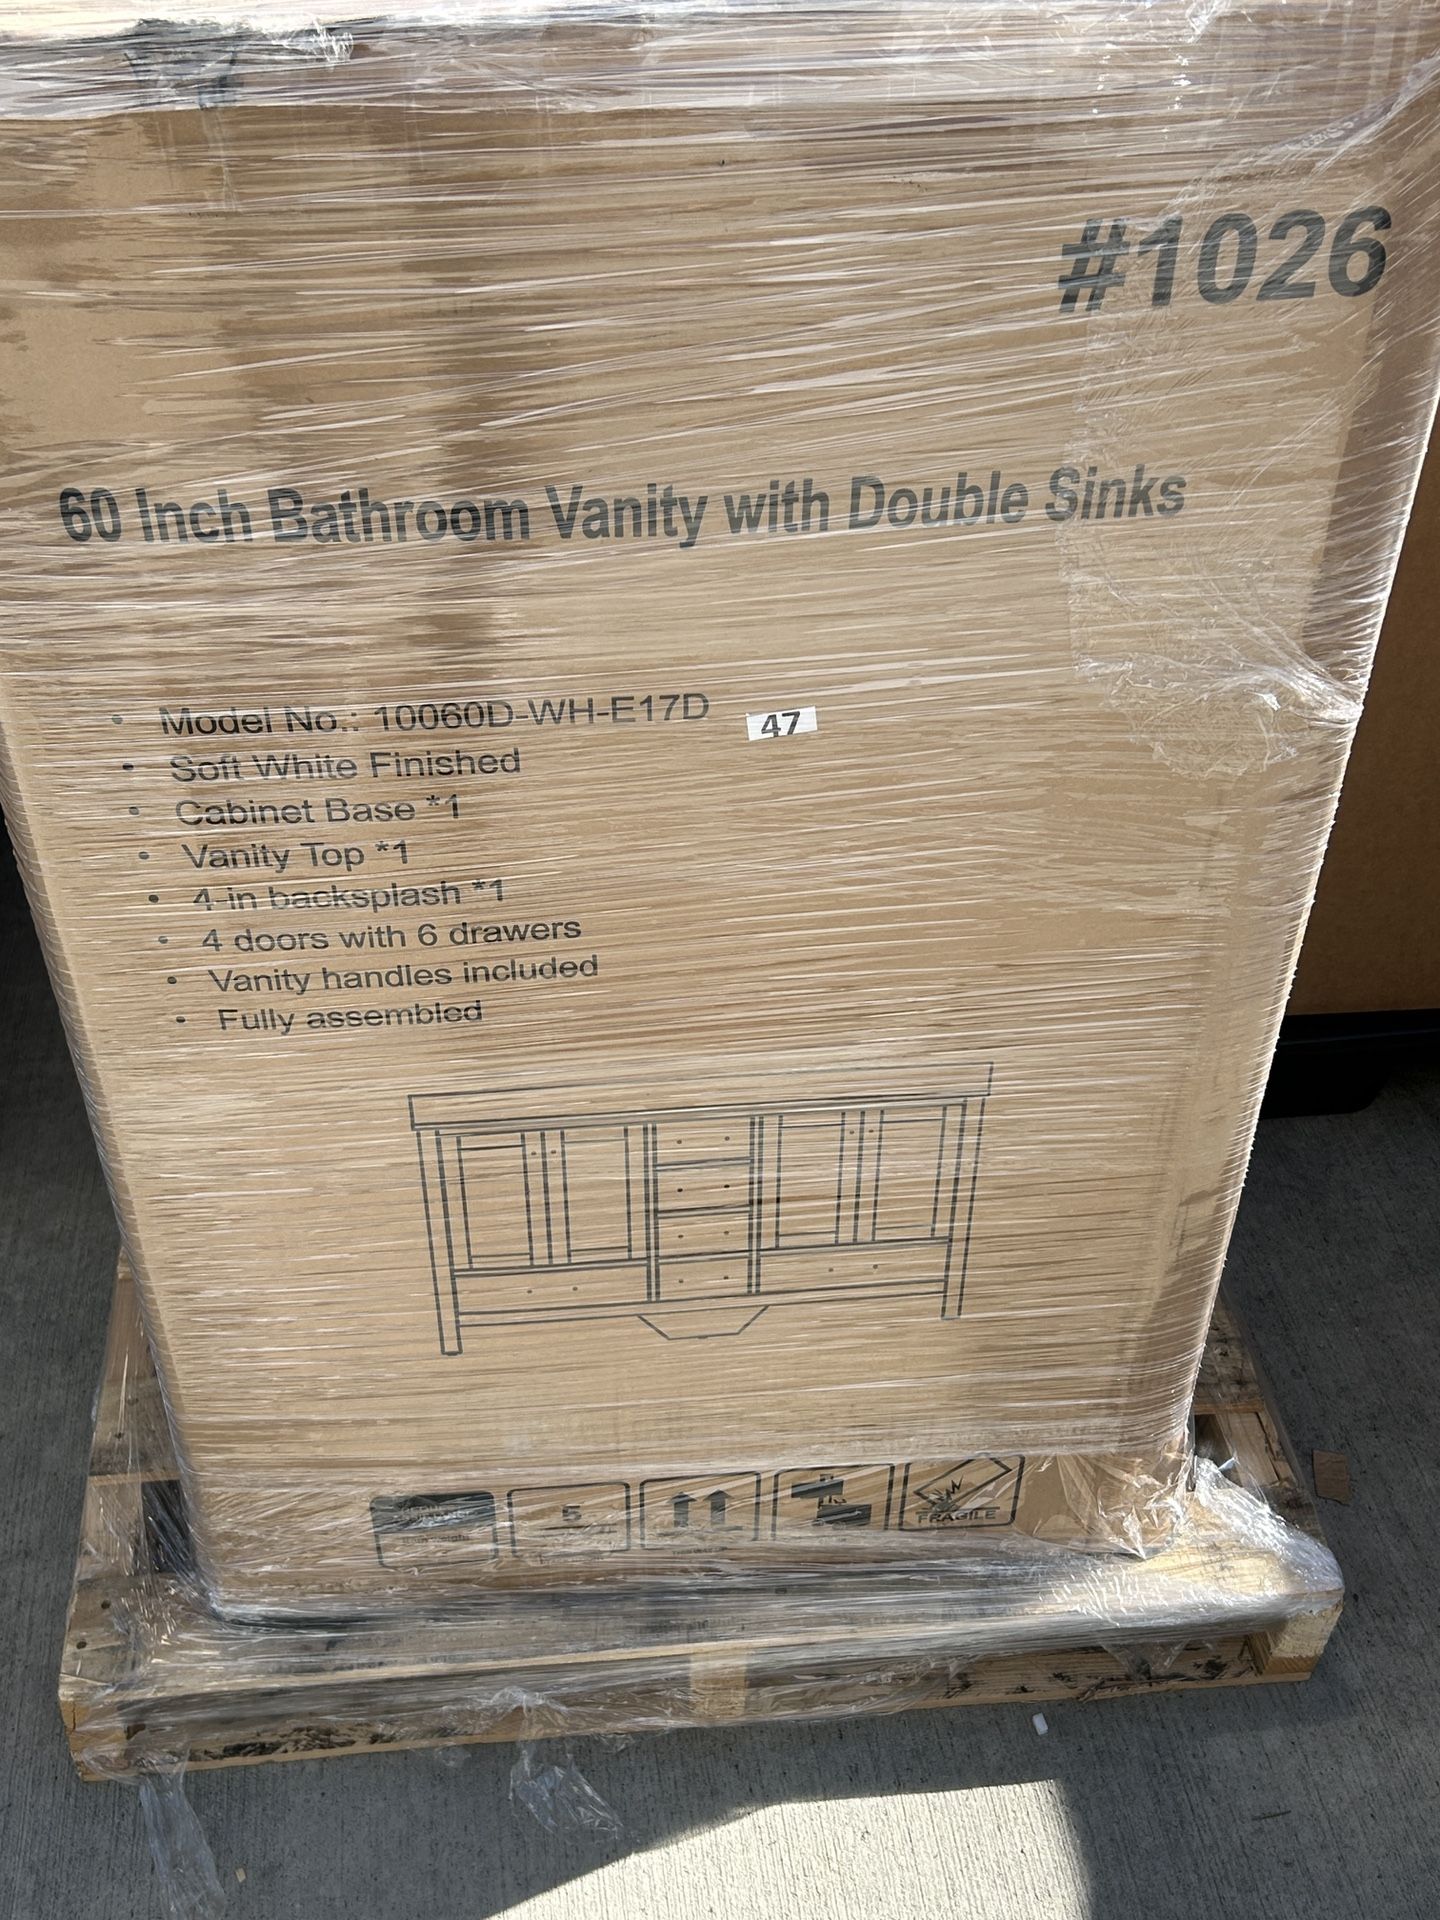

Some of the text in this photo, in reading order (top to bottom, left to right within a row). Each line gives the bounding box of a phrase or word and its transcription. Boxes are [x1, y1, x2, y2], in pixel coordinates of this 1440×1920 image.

[1057, 205, 1392, 313] #1026
[59, 462, 1189, 549] 60 Inch Bathroom Vanity with Double Sinks
[158, 692, 710, 736] Model No.: 10060D-WH-E17D
[760, 710, 801, 737] 47
[170, 747, 521, 783] Soft White Finished
[175, 798, 316, 827] Cabinet
[325, 797, 417, 824] Base
[181, 843, 291, 874] Vanity
[300, 842, 366, 873] Top
[268, 879, 462, 914] backsplash
[202, 921, 583, 952] 4 doors with 6 drawers
[207, 954, 599, 996] Vanity handles included
[218, 999, 483, 1036] Fully assembled
[916, 1508, 997, 1525] FRAGILE
